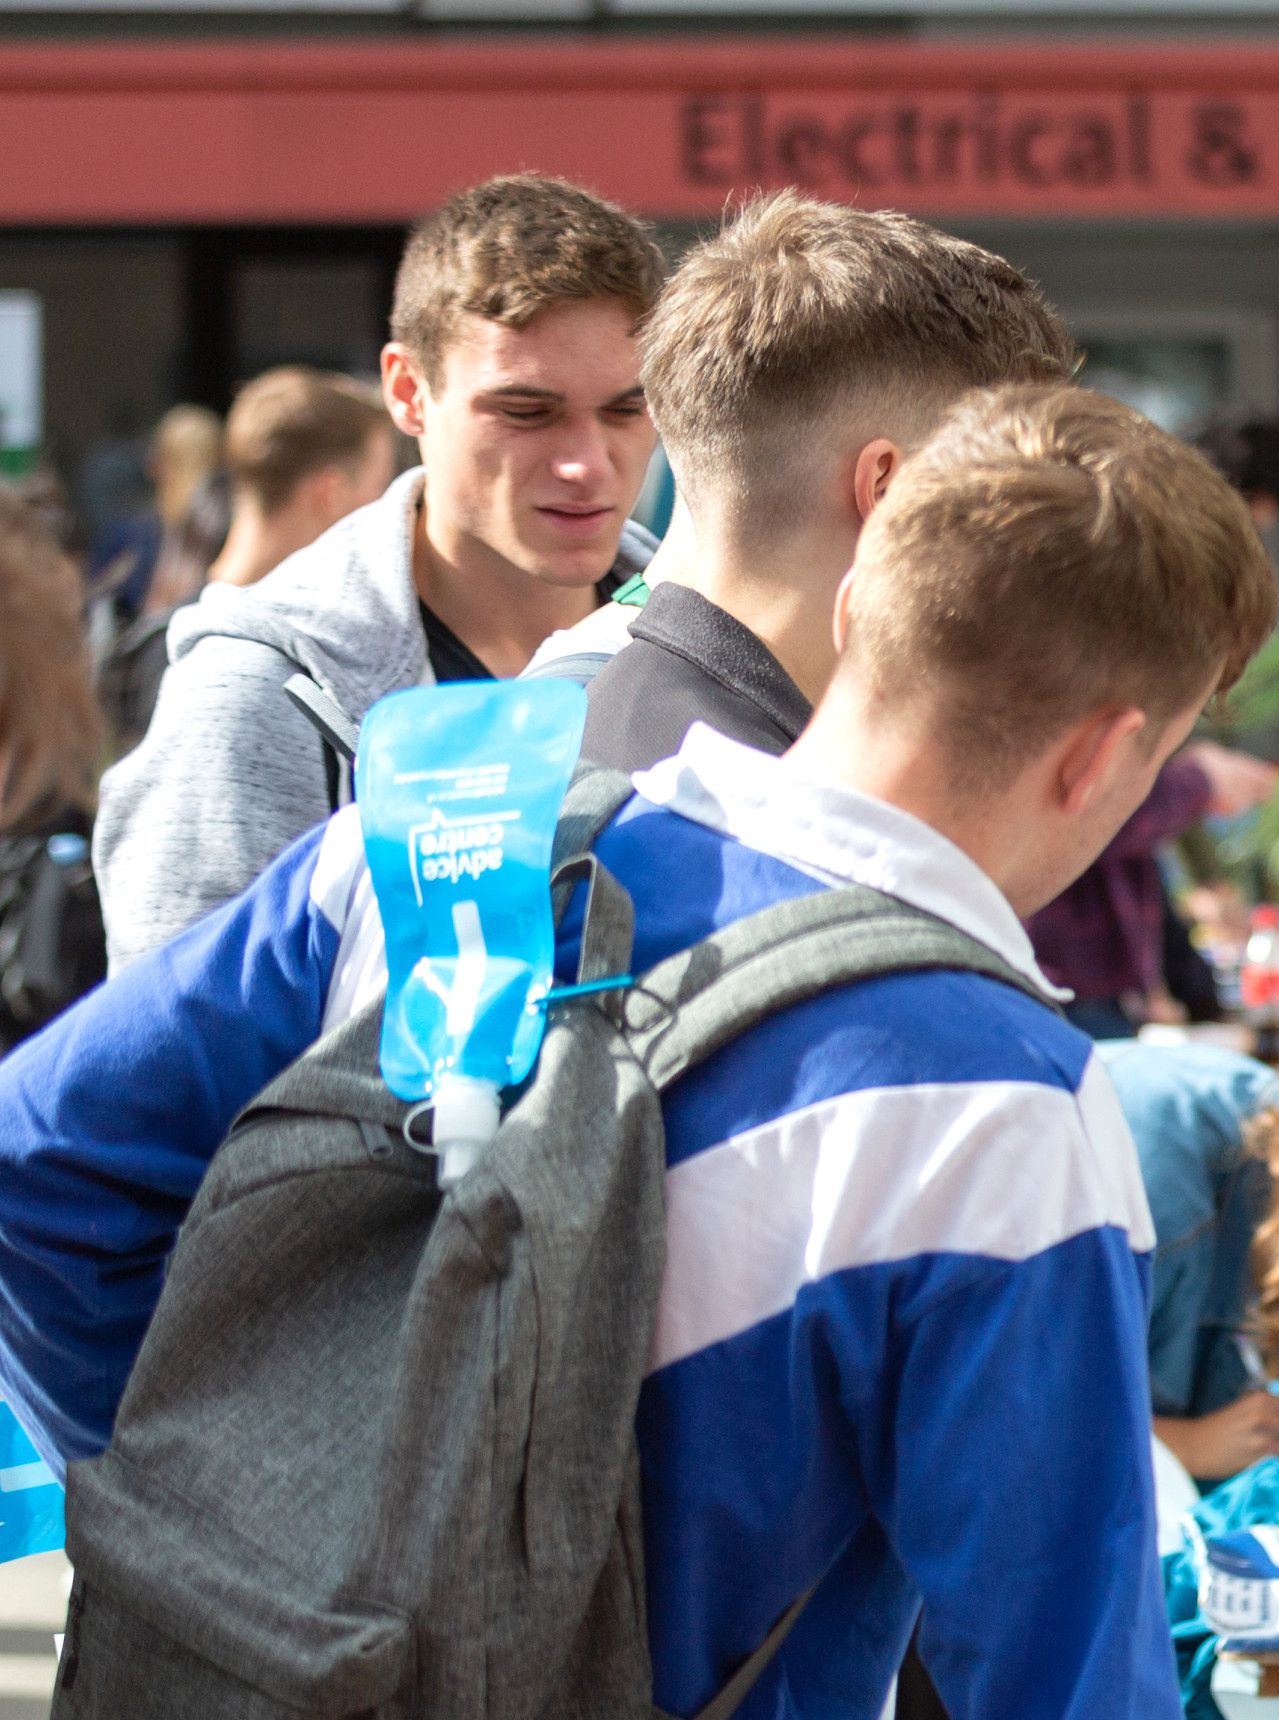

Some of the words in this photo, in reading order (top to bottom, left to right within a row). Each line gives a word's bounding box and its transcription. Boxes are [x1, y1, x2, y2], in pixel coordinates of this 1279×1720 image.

[677, 95, 1155, 190] Electrical
[1184, 100, 1264, 190] &
[420, 823, 504, 857] centre
[421, 847, 503, 884] advice
